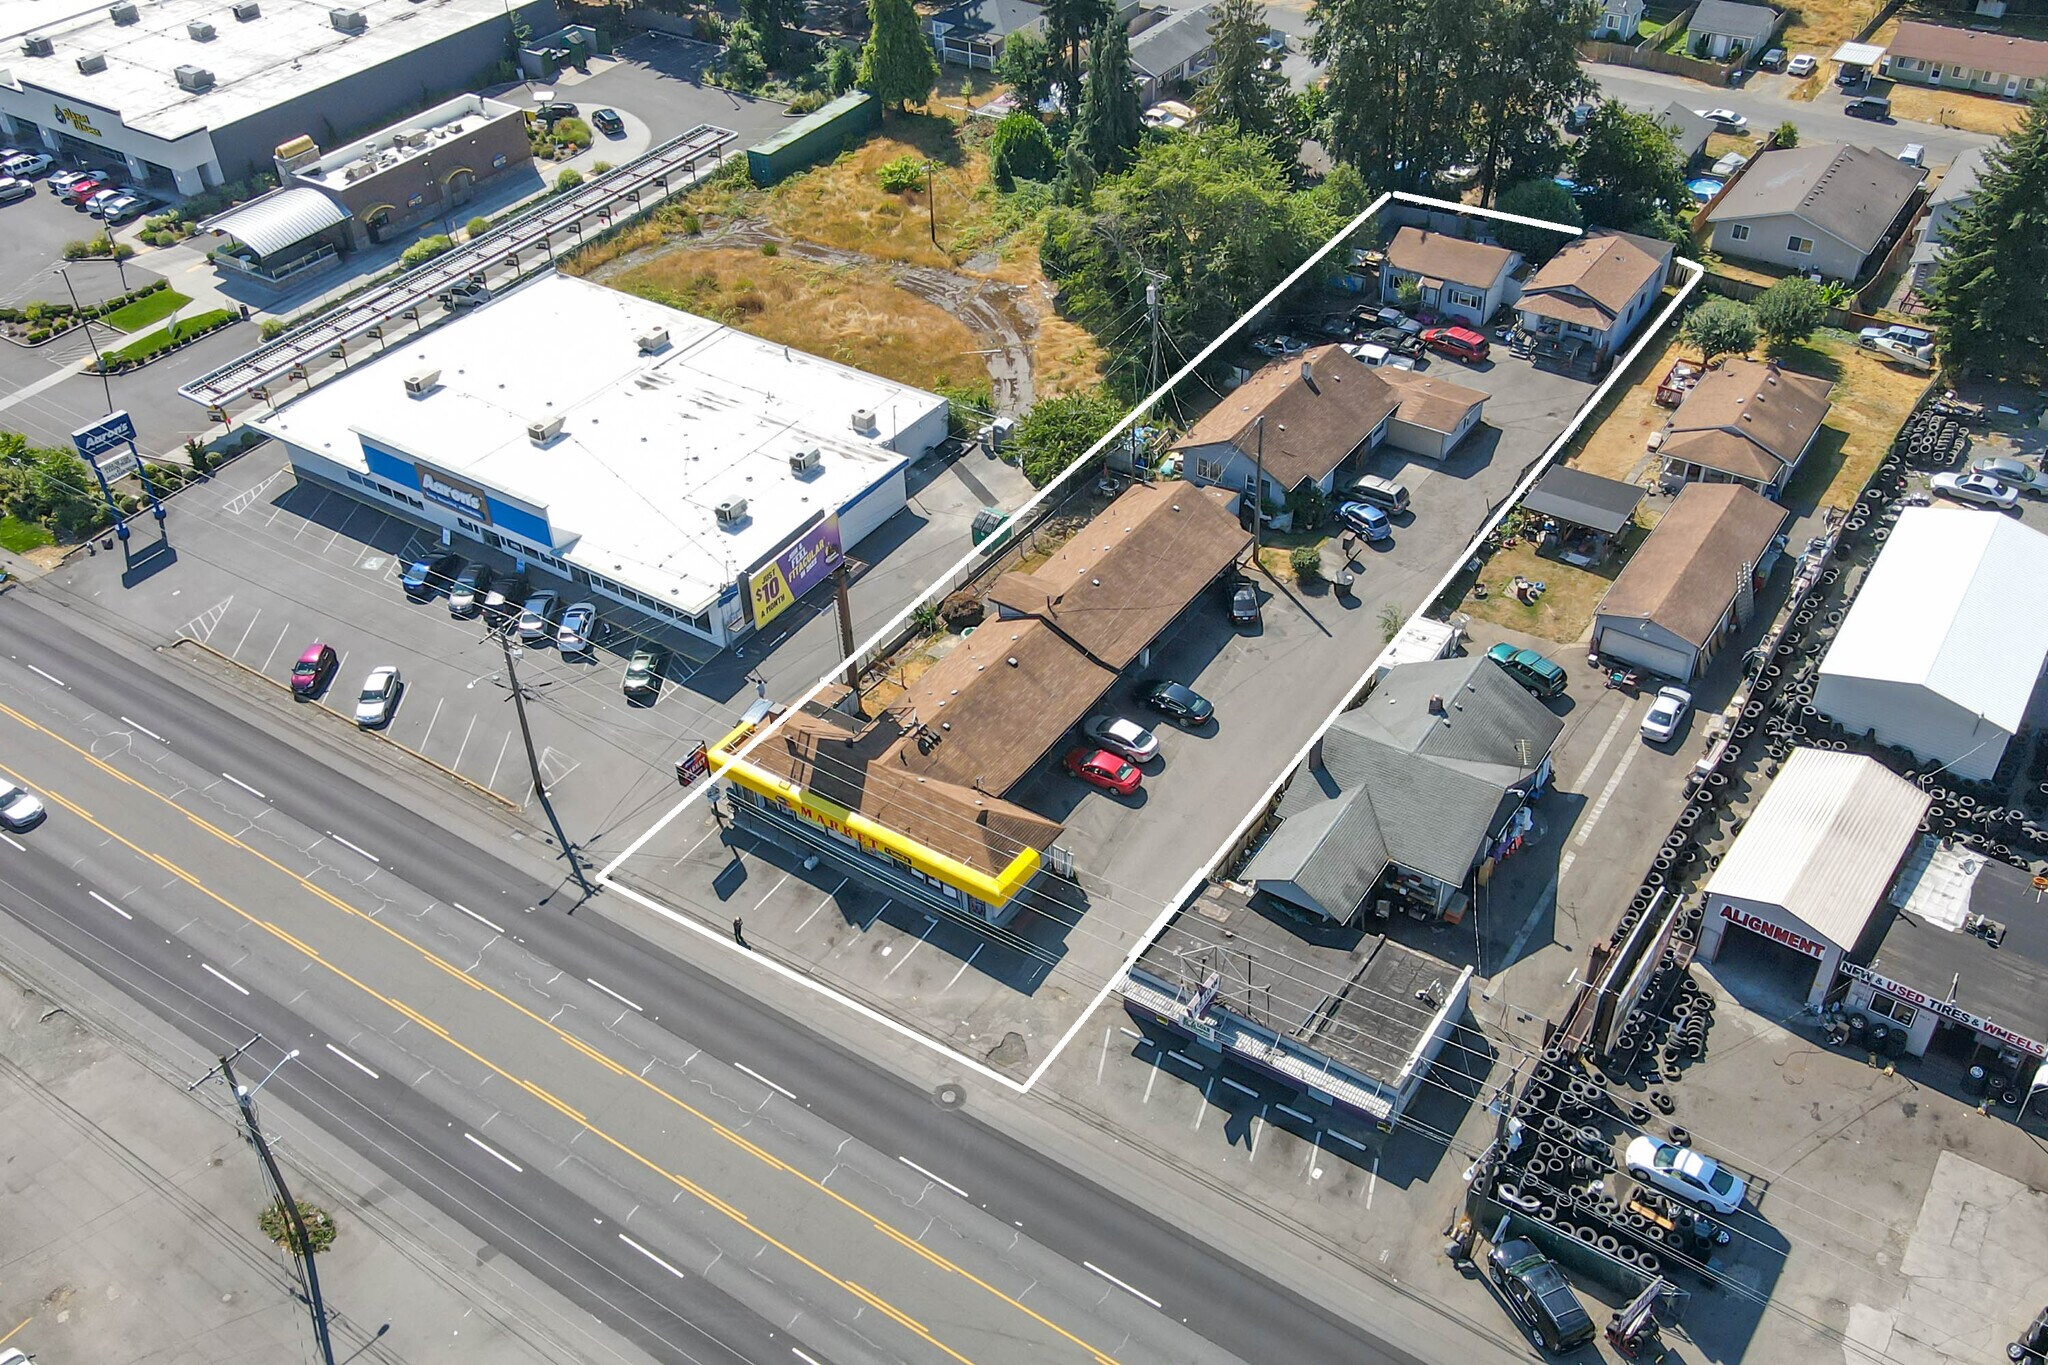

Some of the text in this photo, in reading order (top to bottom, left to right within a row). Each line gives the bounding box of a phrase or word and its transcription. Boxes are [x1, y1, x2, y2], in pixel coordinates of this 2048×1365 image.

[85, 423, 128, 449] Aaron's
[791, 547, 808, 568] FEEL
[755, 576, 780, 604] $10
[762, 568, 776, 585] JUST
[766, 593, 786, 614] MONTH
[801, 806, 878, 848] MARKET
[1720, 905, 1825, 957] ALIGNMENT
[1841, 962, 2045, 1055] NEW & USED TIRES & WHEELS
